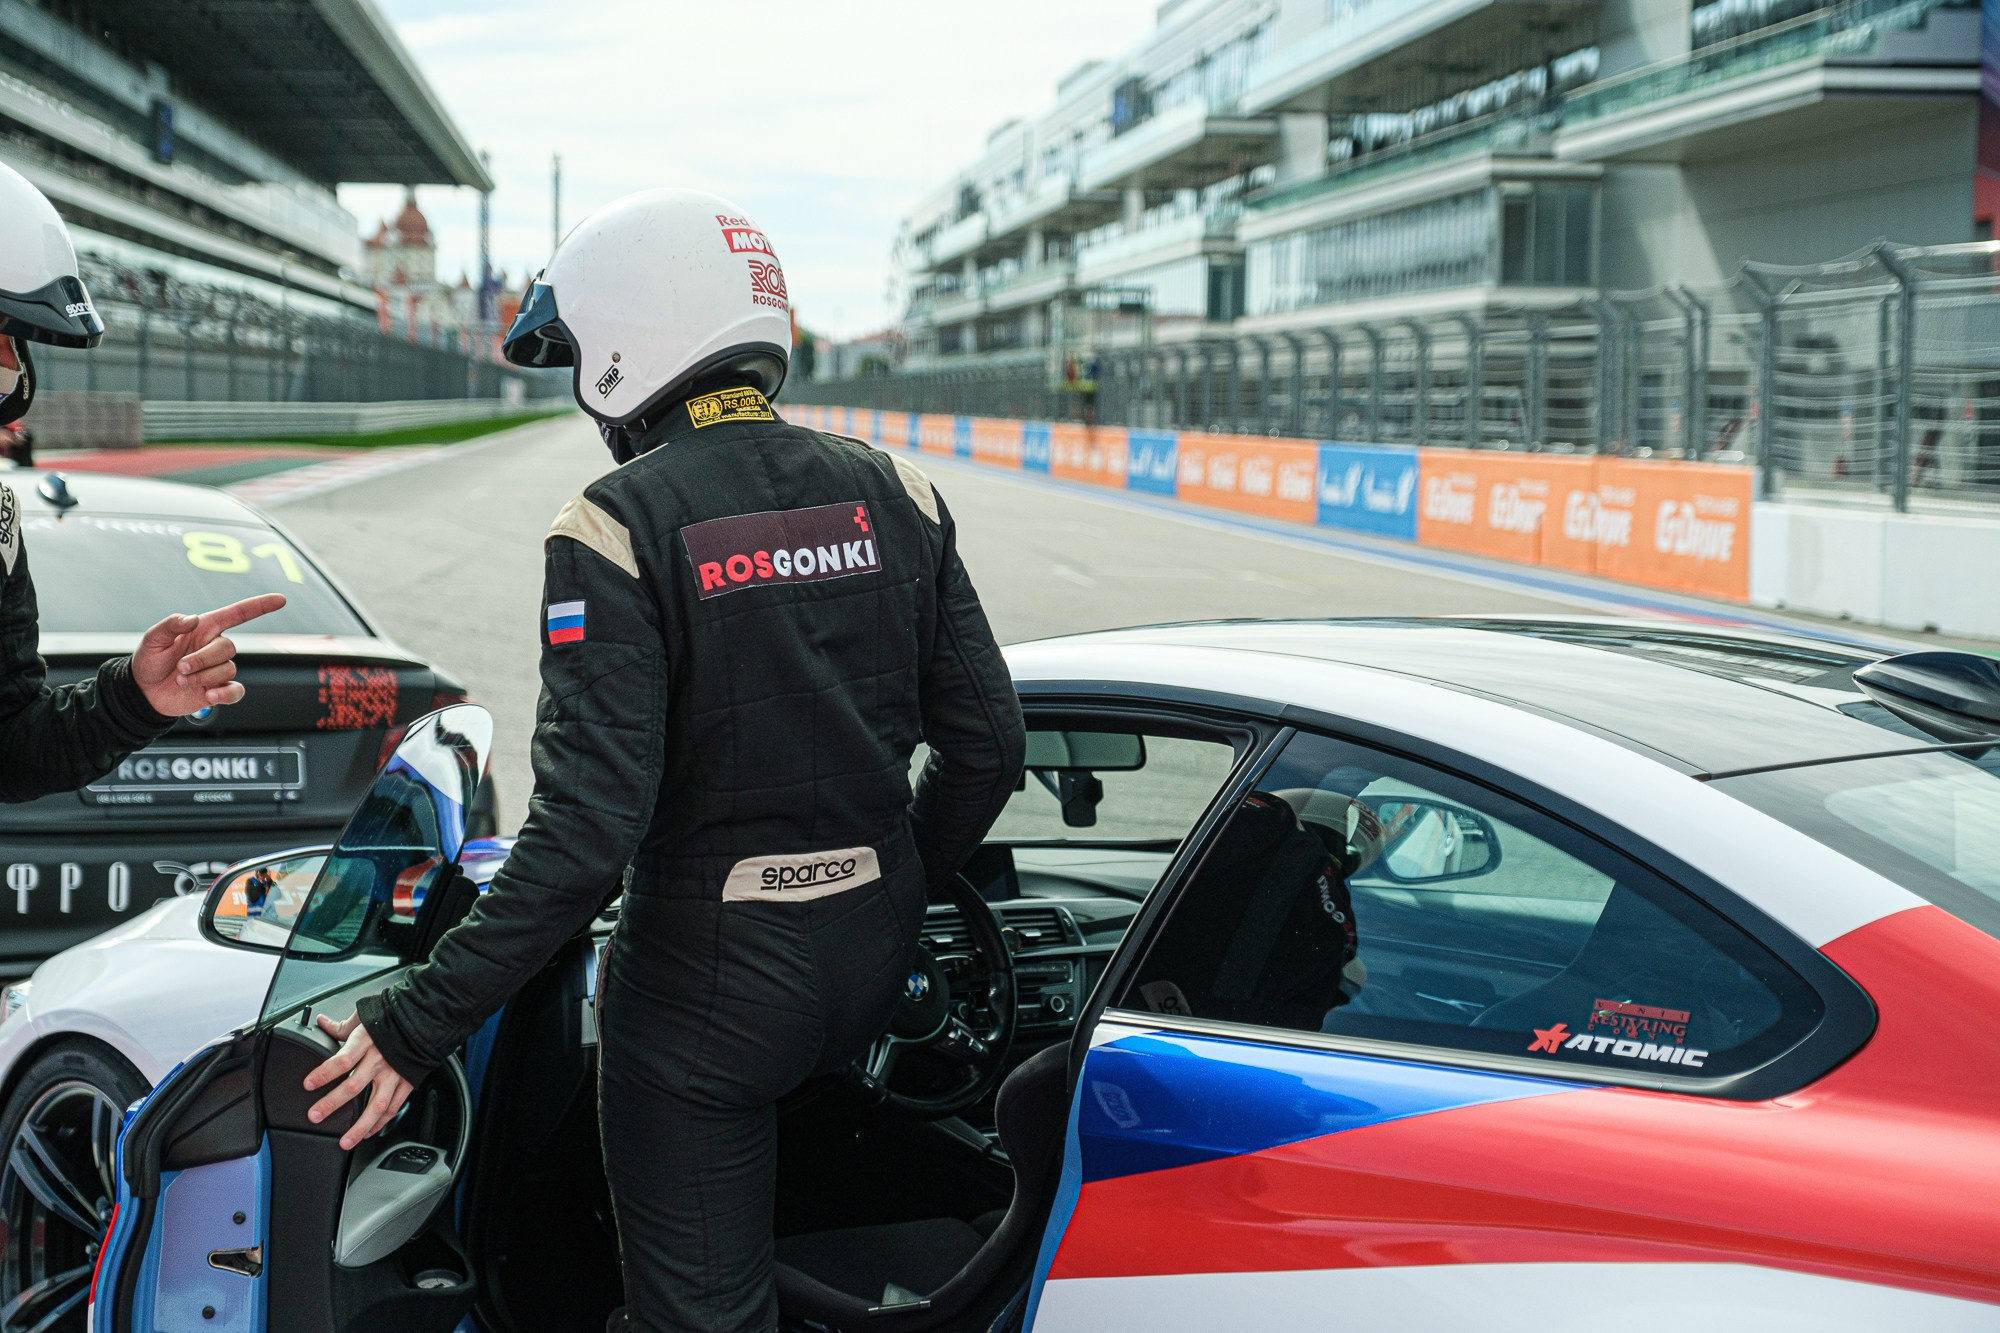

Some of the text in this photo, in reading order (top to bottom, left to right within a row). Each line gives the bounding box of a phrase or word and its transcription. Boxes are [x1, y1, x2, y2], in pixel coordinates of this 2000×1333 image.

[598, 367, 620, 395] OMP
[694, 400, 720, 418] FIA
[182, 531, 304, 584] 81
[698, 539, 876, 591] ROSGONKI
[118, 757, 259, 781] ROSGONKI
[761, 858, 857, 891] sparco
[1564, 1034, 1709, 1067] ATOMIC
